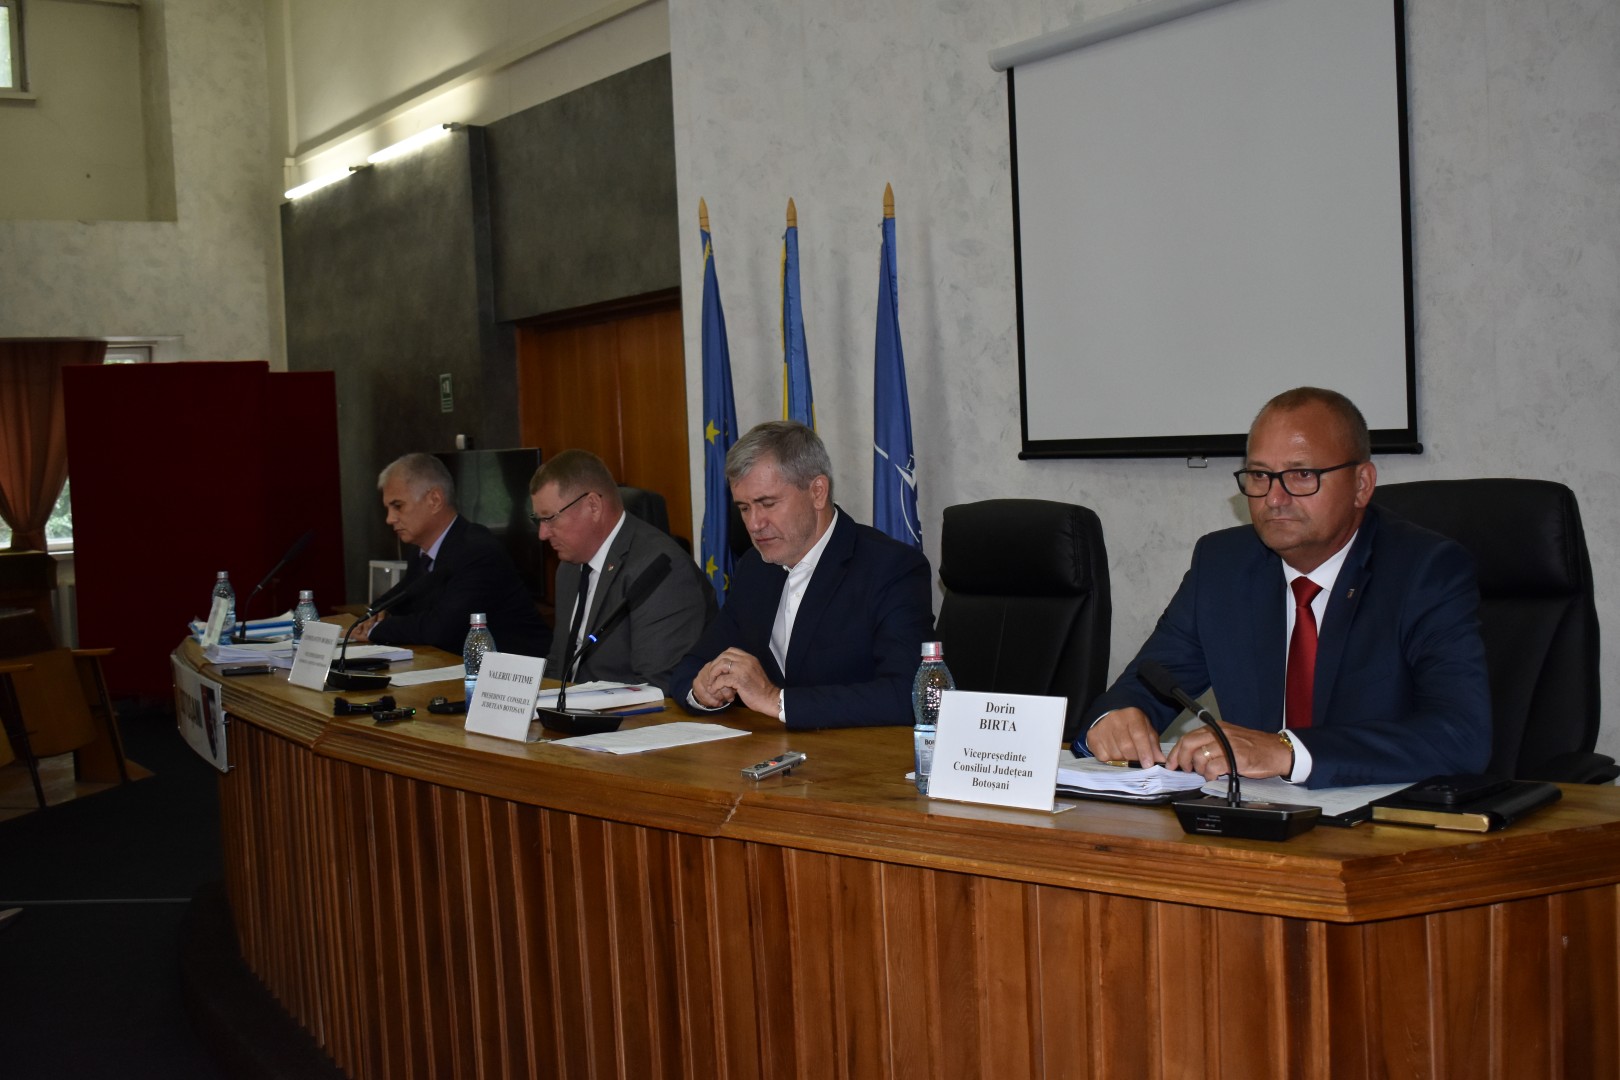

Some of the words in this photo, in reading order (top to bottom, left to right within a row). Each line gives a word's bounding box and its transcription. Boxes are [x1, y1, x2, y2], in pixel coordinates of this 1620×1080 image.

[489, 670, 512, 681] VALERIU
[512, 674, 533, 685] IFTIME
[986, 701, 1015, 714] Dorin
[979, 718, 1016, 732] BIRTA
[963, 747, 1027, 763] Vicepreședinte
[953, 761, 991, 774] Consiliul
[992, 766, 1033, 778] Județean
[972, 777, 1009, 790] Botoșani
